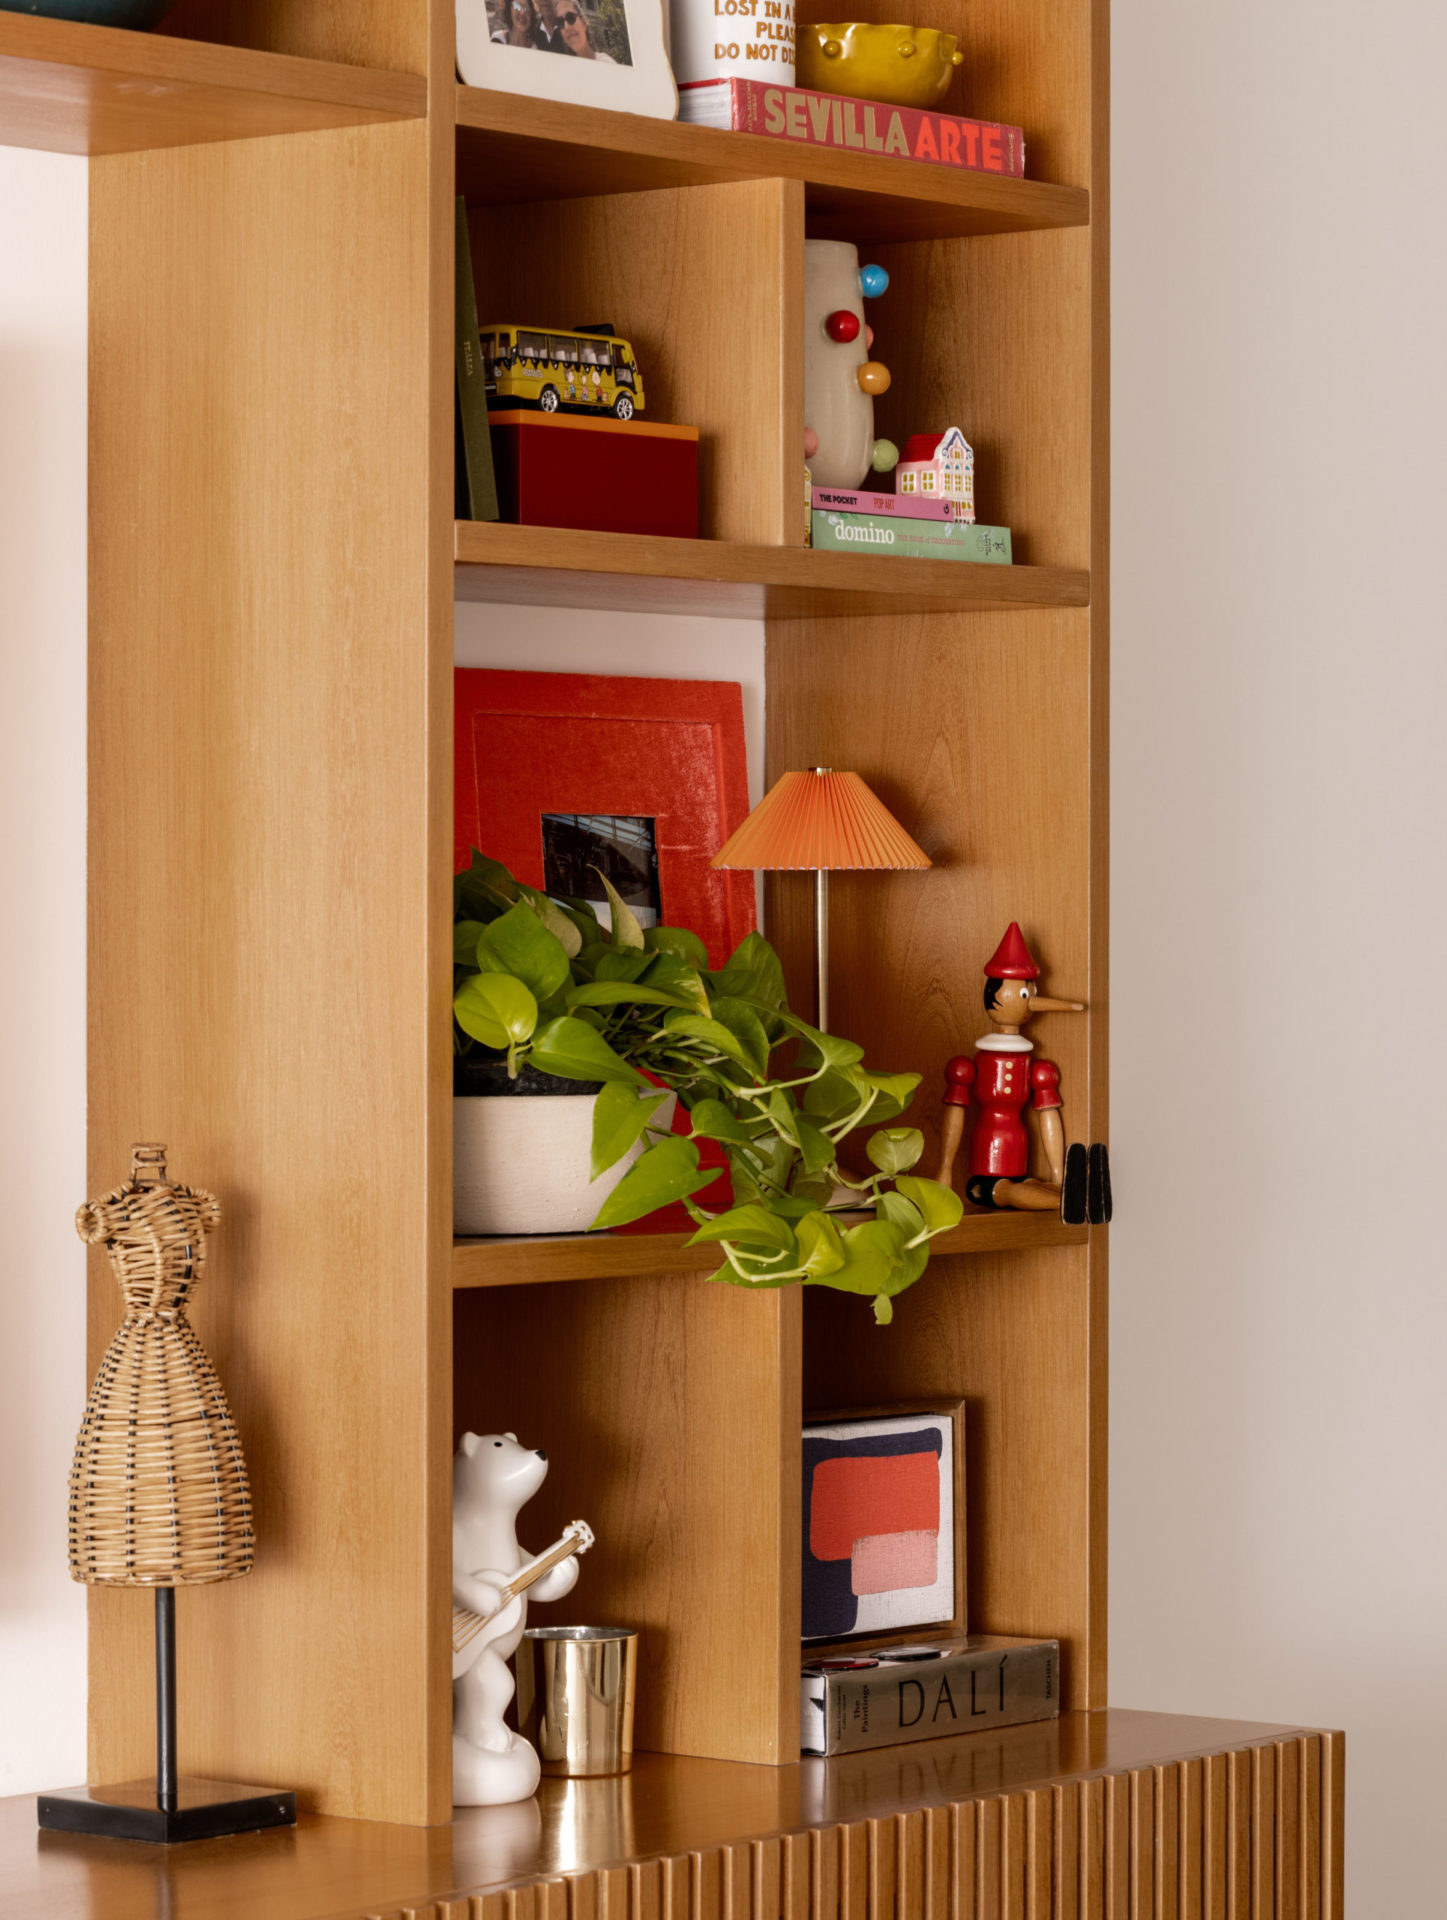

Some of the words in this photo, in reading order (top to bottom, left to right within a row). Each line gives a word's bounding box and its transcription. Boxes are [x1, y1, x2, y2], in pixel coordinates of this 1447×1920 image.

[714, 0, 759, 16] LOST
[764, 1, 782, 19] IN
[784, 4, 791, 20] A
[714, 43, 740, 60] DO
[746, 43, 778, 61] NOT
[764, 88, 910, 157] SEVILLA
[914, 116, 1001, 171] ARTE
[819, 493, 832, 504] THE
[832, 495, 858, 506] POCKET
[873, 497, 885, 509] POP
[885, 498, 895, 511] ART
[835, 519, 895, 544] domino
[899, 1654, 1009, 1728] DALÍ
[862, 1684, 870, 1733] Paintings
